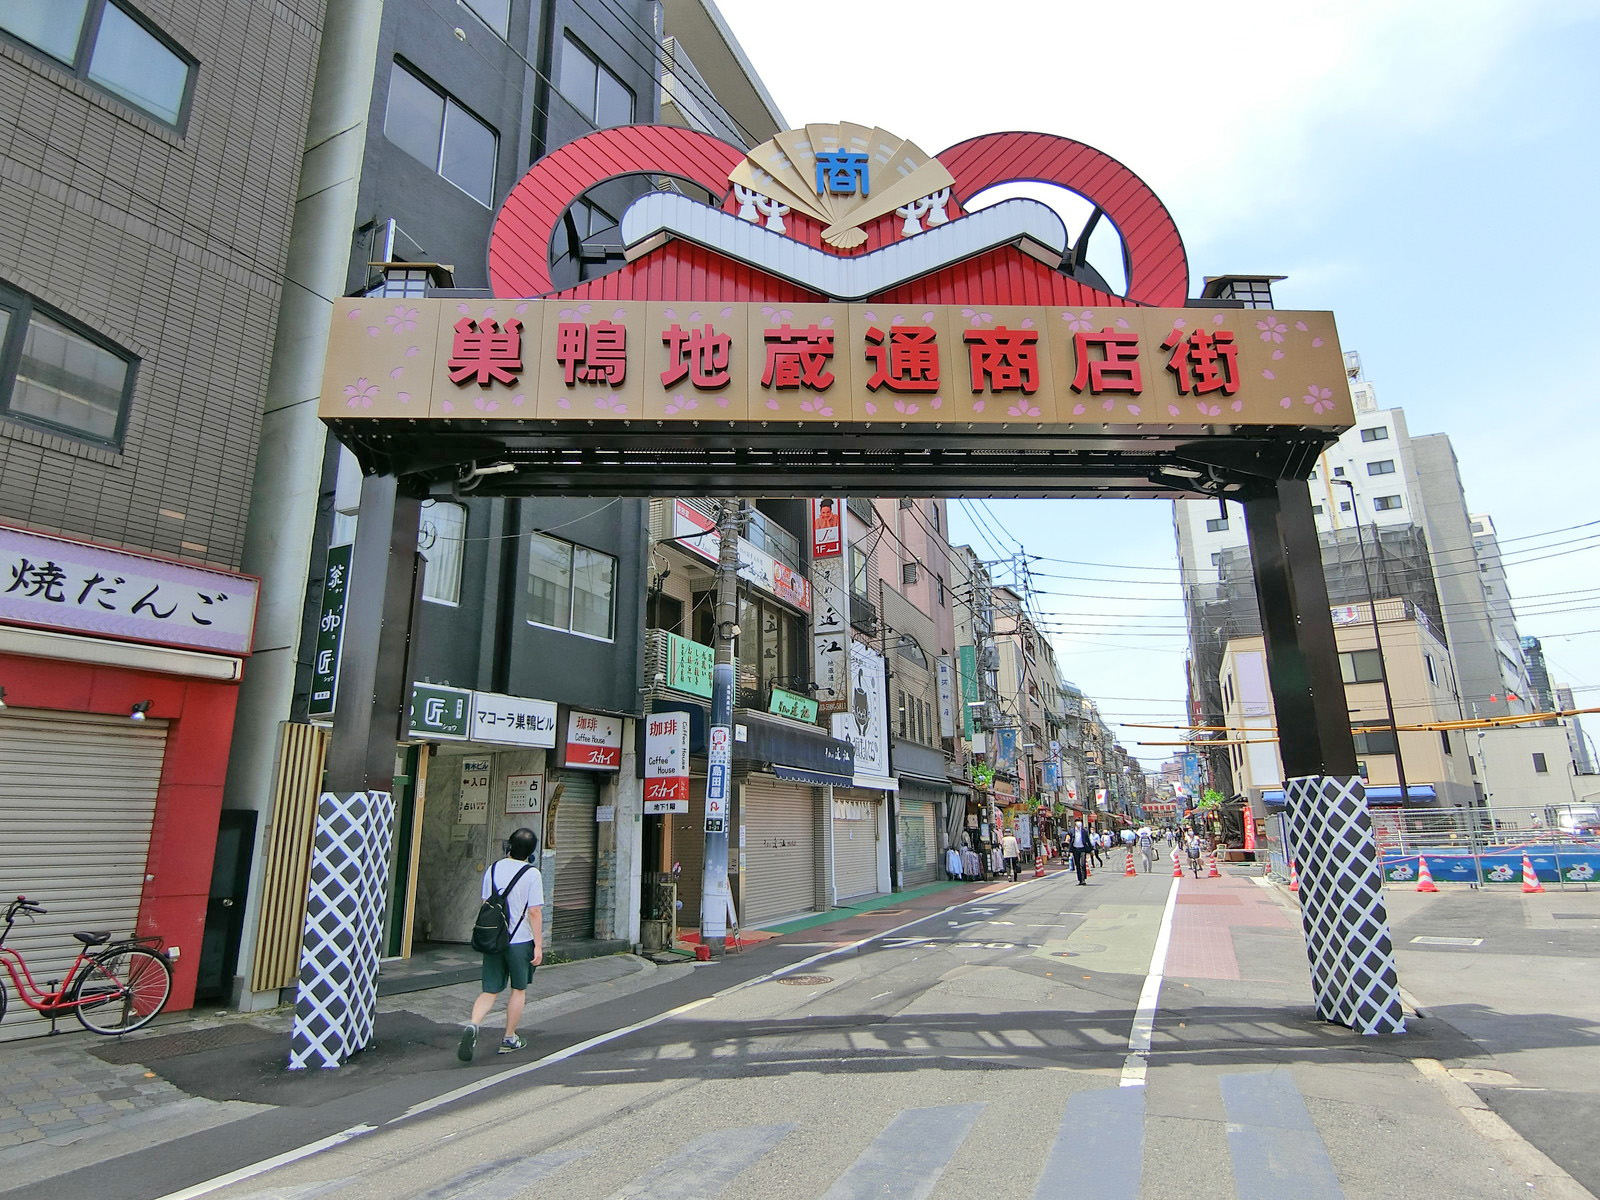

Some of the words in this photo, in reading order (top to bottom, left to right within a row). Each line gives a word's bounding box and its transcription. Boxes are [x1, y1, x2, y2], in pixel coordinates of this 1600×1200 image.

[816, 147, 869, 198] 商
[447, 316, 1242, 397] 巣鴨地蔵通商店街
[816, 545, 826, 554] 1F
[5, 558, 229, 625] 焼だんご
[477, 711, 555, 732] マコーラ巣鴨ビル
[576, 716, 598, 731] 珈琲
[650, 719, 678, 736] 珈琲
[575, 732, 590, 743] Coffee
[592, 735, 606, 744] House
[588, 748, 614, 764] スカイ
[648, 755, 668, 765] Coffee
[657, 766, 676, 774] House
[470, 778, 487, 787] 入口
[648, 779, 679, 798] スカイ
[528, 779, 538, 808] 占い
[653, 803, 676, 811] 地下1階
